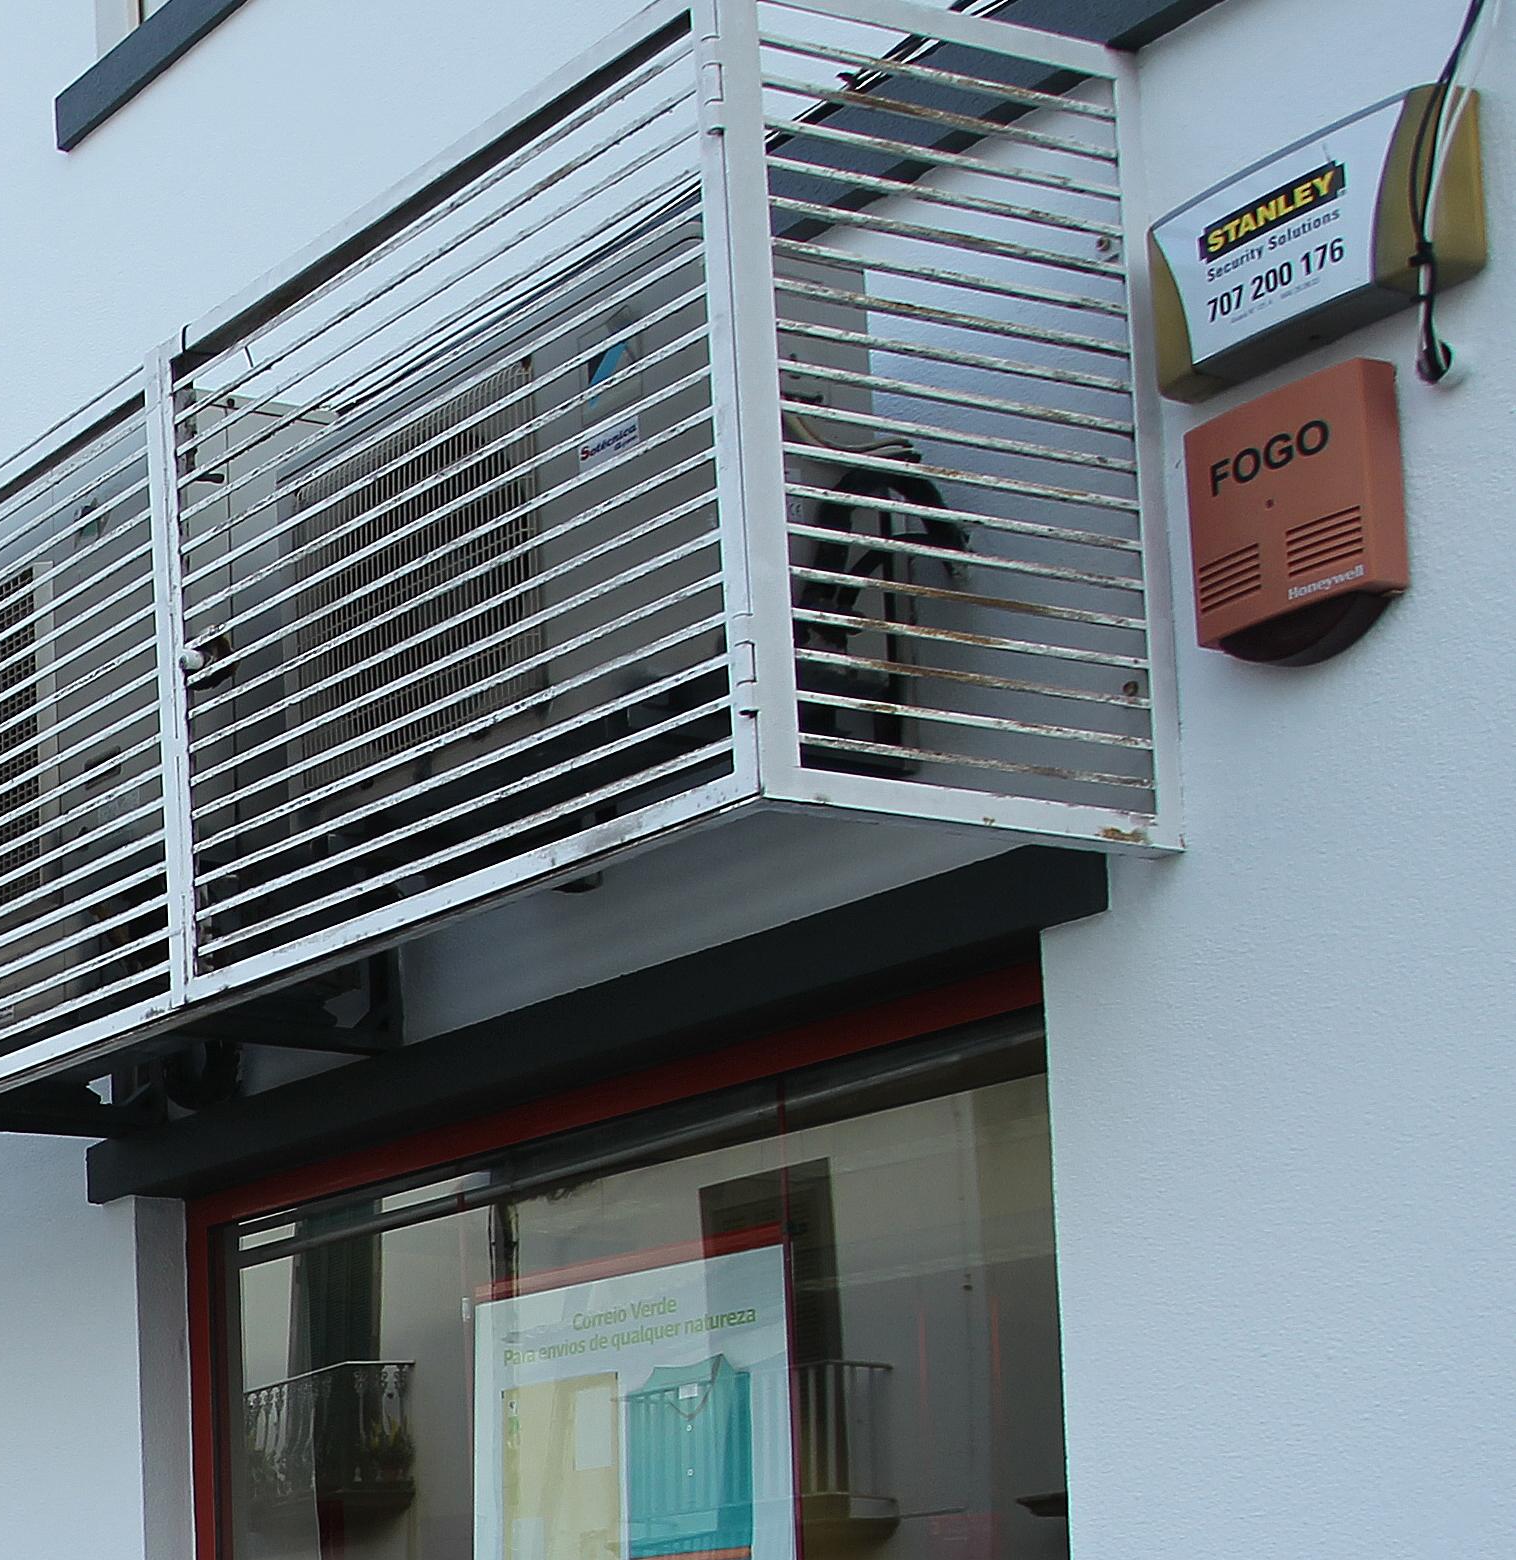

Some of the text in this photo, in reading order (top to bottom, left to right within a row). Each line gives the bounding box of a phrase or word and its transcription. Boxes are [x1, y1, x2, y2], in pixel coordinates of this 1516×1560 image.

[1207, 170, 1335, 253] STANLEY
[1207, 209, 1341, 282] Security Solutions
[1207, 284, 1244, 323] 707
[1250, 261, 1293, 300] 200
[1301, 237, 1345, 276] 176
[1210, 420, 1330, 497] FOGO
[1287, 564, 1365, 600] Honeywell
[504, 1308, 757, 1367] Para envios de qualquer natureza
[572, 1297, 677, 1331] Correio Verde
